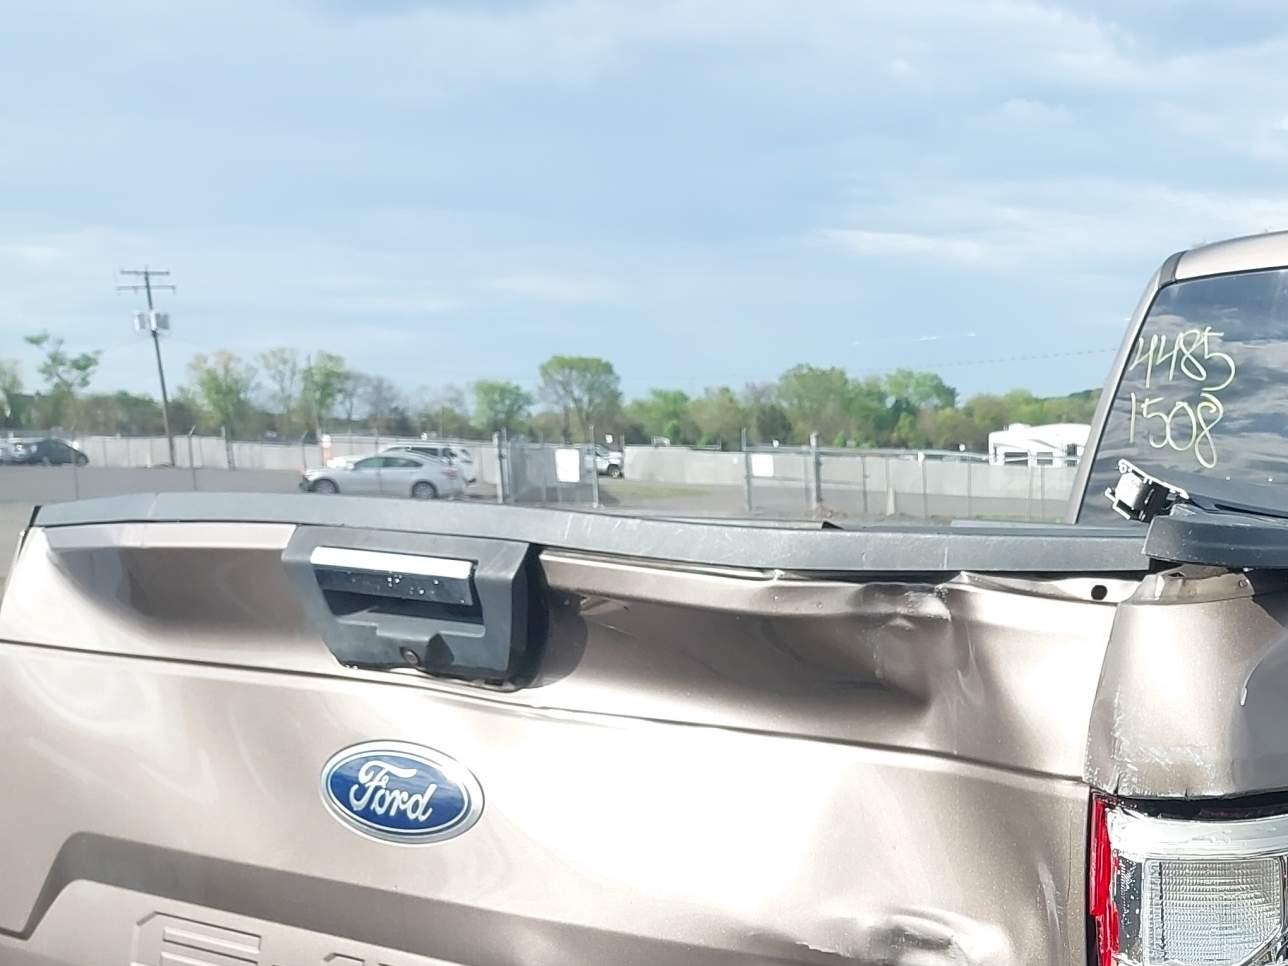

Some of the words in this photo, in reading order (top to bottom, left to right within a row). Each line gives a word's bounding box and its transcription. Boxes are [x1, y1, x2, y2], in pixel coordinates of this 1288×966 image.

[1129, 327, 1235, 391] 4485
[1129, 393, 1223, 468] 1508
[350, 759, 438, 822] Ford
